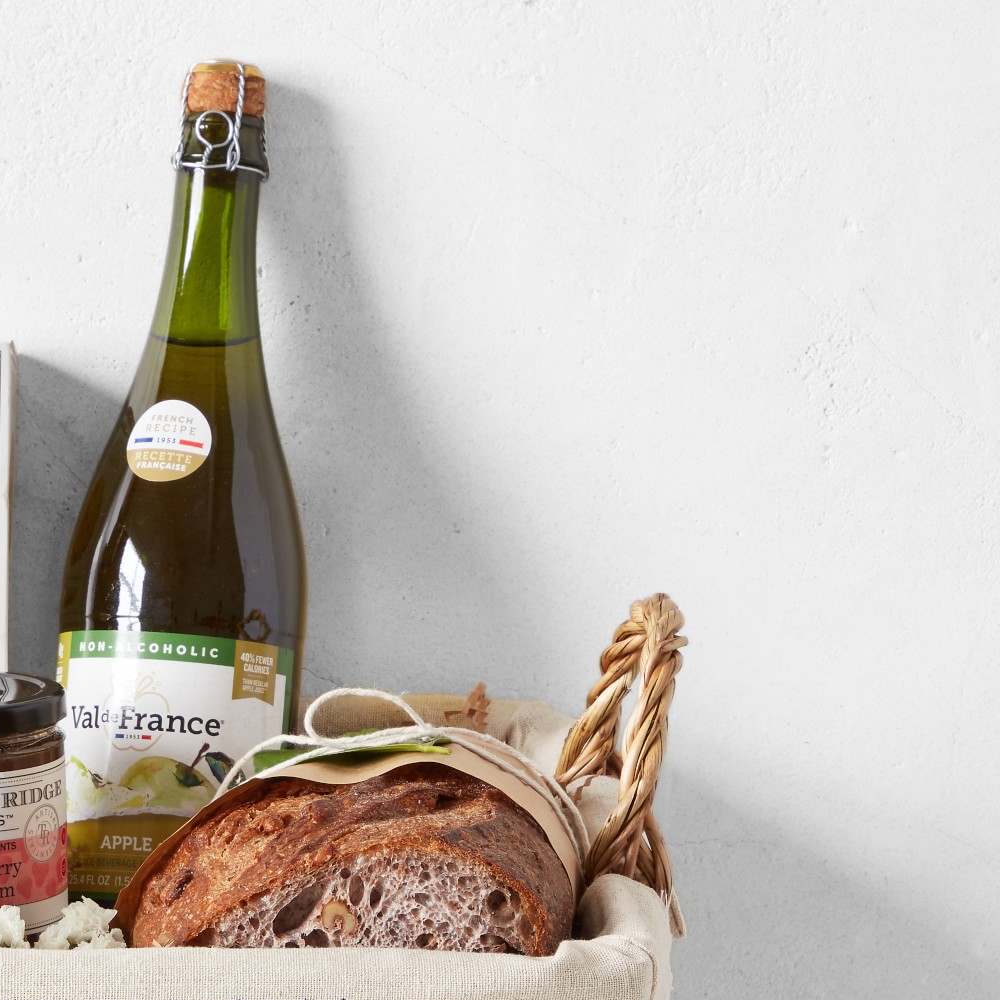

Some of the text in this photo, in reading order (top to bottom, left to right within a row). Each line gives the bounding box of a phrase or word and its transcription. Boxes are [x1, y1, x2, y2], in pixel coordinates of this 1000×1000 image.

[151, 414, 194, 424] FRENCH
[145, 423, 198, 436] RECIPE
[135, 451, 192, 464] RECETTE
[136, 461, 188, 472] FRANÇAISE
[79, 640, 220, 659] NON-ALCOHOLIC
[240, 652, 273, 666] 40% FEWER
[243, 663, 270, 675] CALORIES
[2, 779, 62, 809] RIDGE
[100, 835, 152, 852] APPLE
[96, 857, 137, 868] BEVERAGE
[87, 875, 95, 885] FL
[97, 875, 110, 886] OZ
